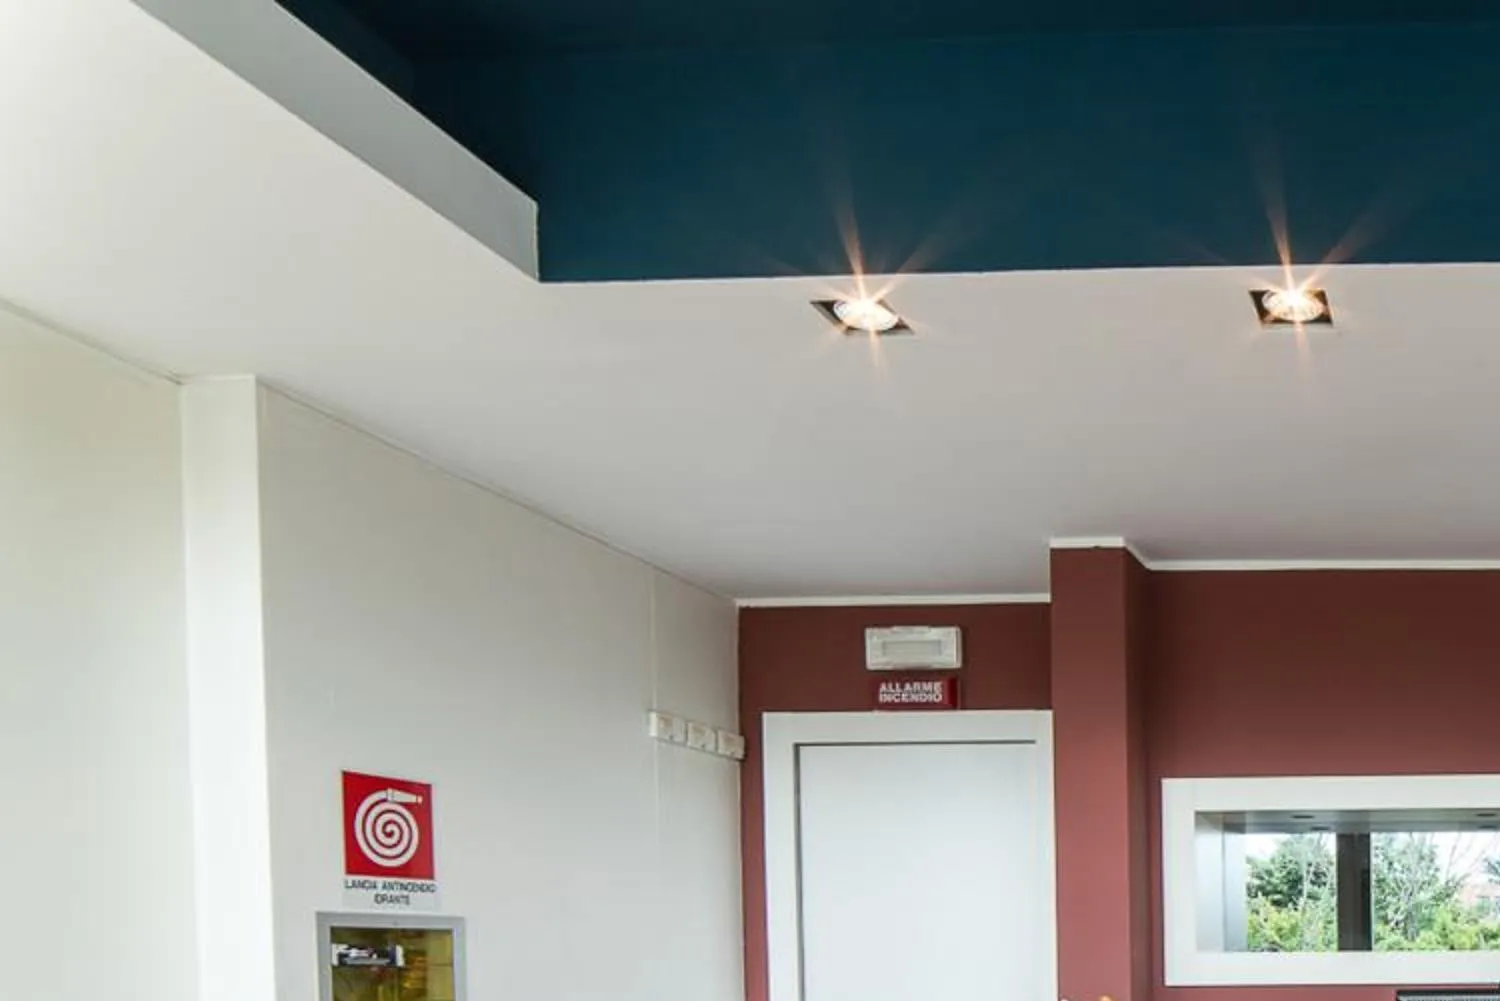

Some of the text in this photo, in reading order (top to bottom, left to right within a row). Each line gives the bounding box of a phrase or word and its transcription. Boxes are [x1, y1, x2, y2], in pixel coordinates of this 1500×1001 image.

[880, 681, 943, 692] ALLARME
[879, 692, 943, 704] INCENDIO
[344, 879, 437, 893] LANCIA ANTINCENDIO
[374, 893, 410, 905] IDRANTE
